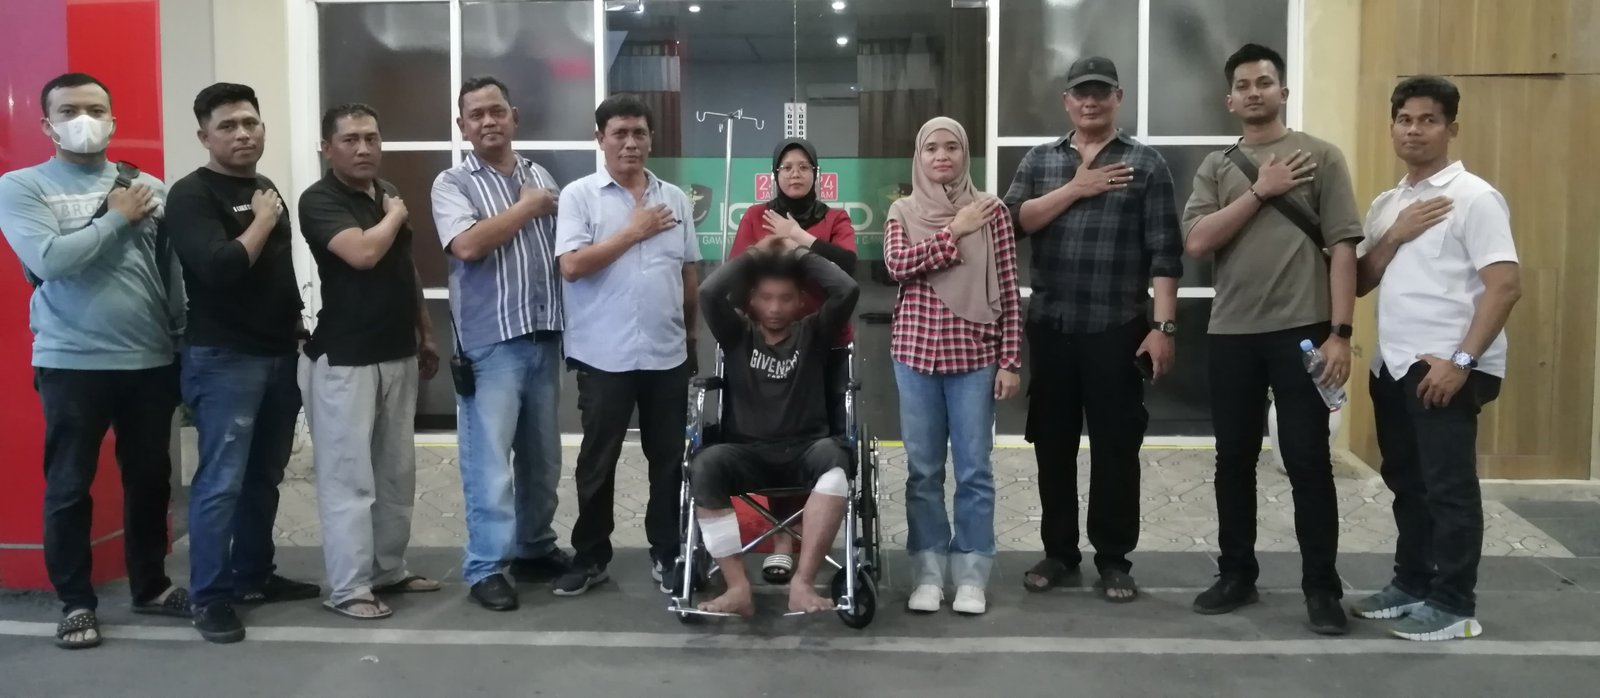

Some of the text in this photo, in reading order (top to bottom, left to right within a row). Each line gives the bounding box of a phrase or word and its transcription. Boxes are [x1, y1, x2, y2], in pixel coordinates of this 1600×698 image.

[759, 175, 771, 190] 2
[820, 191, 834, 199] AM
[61, 203, 96, 217] BRO
